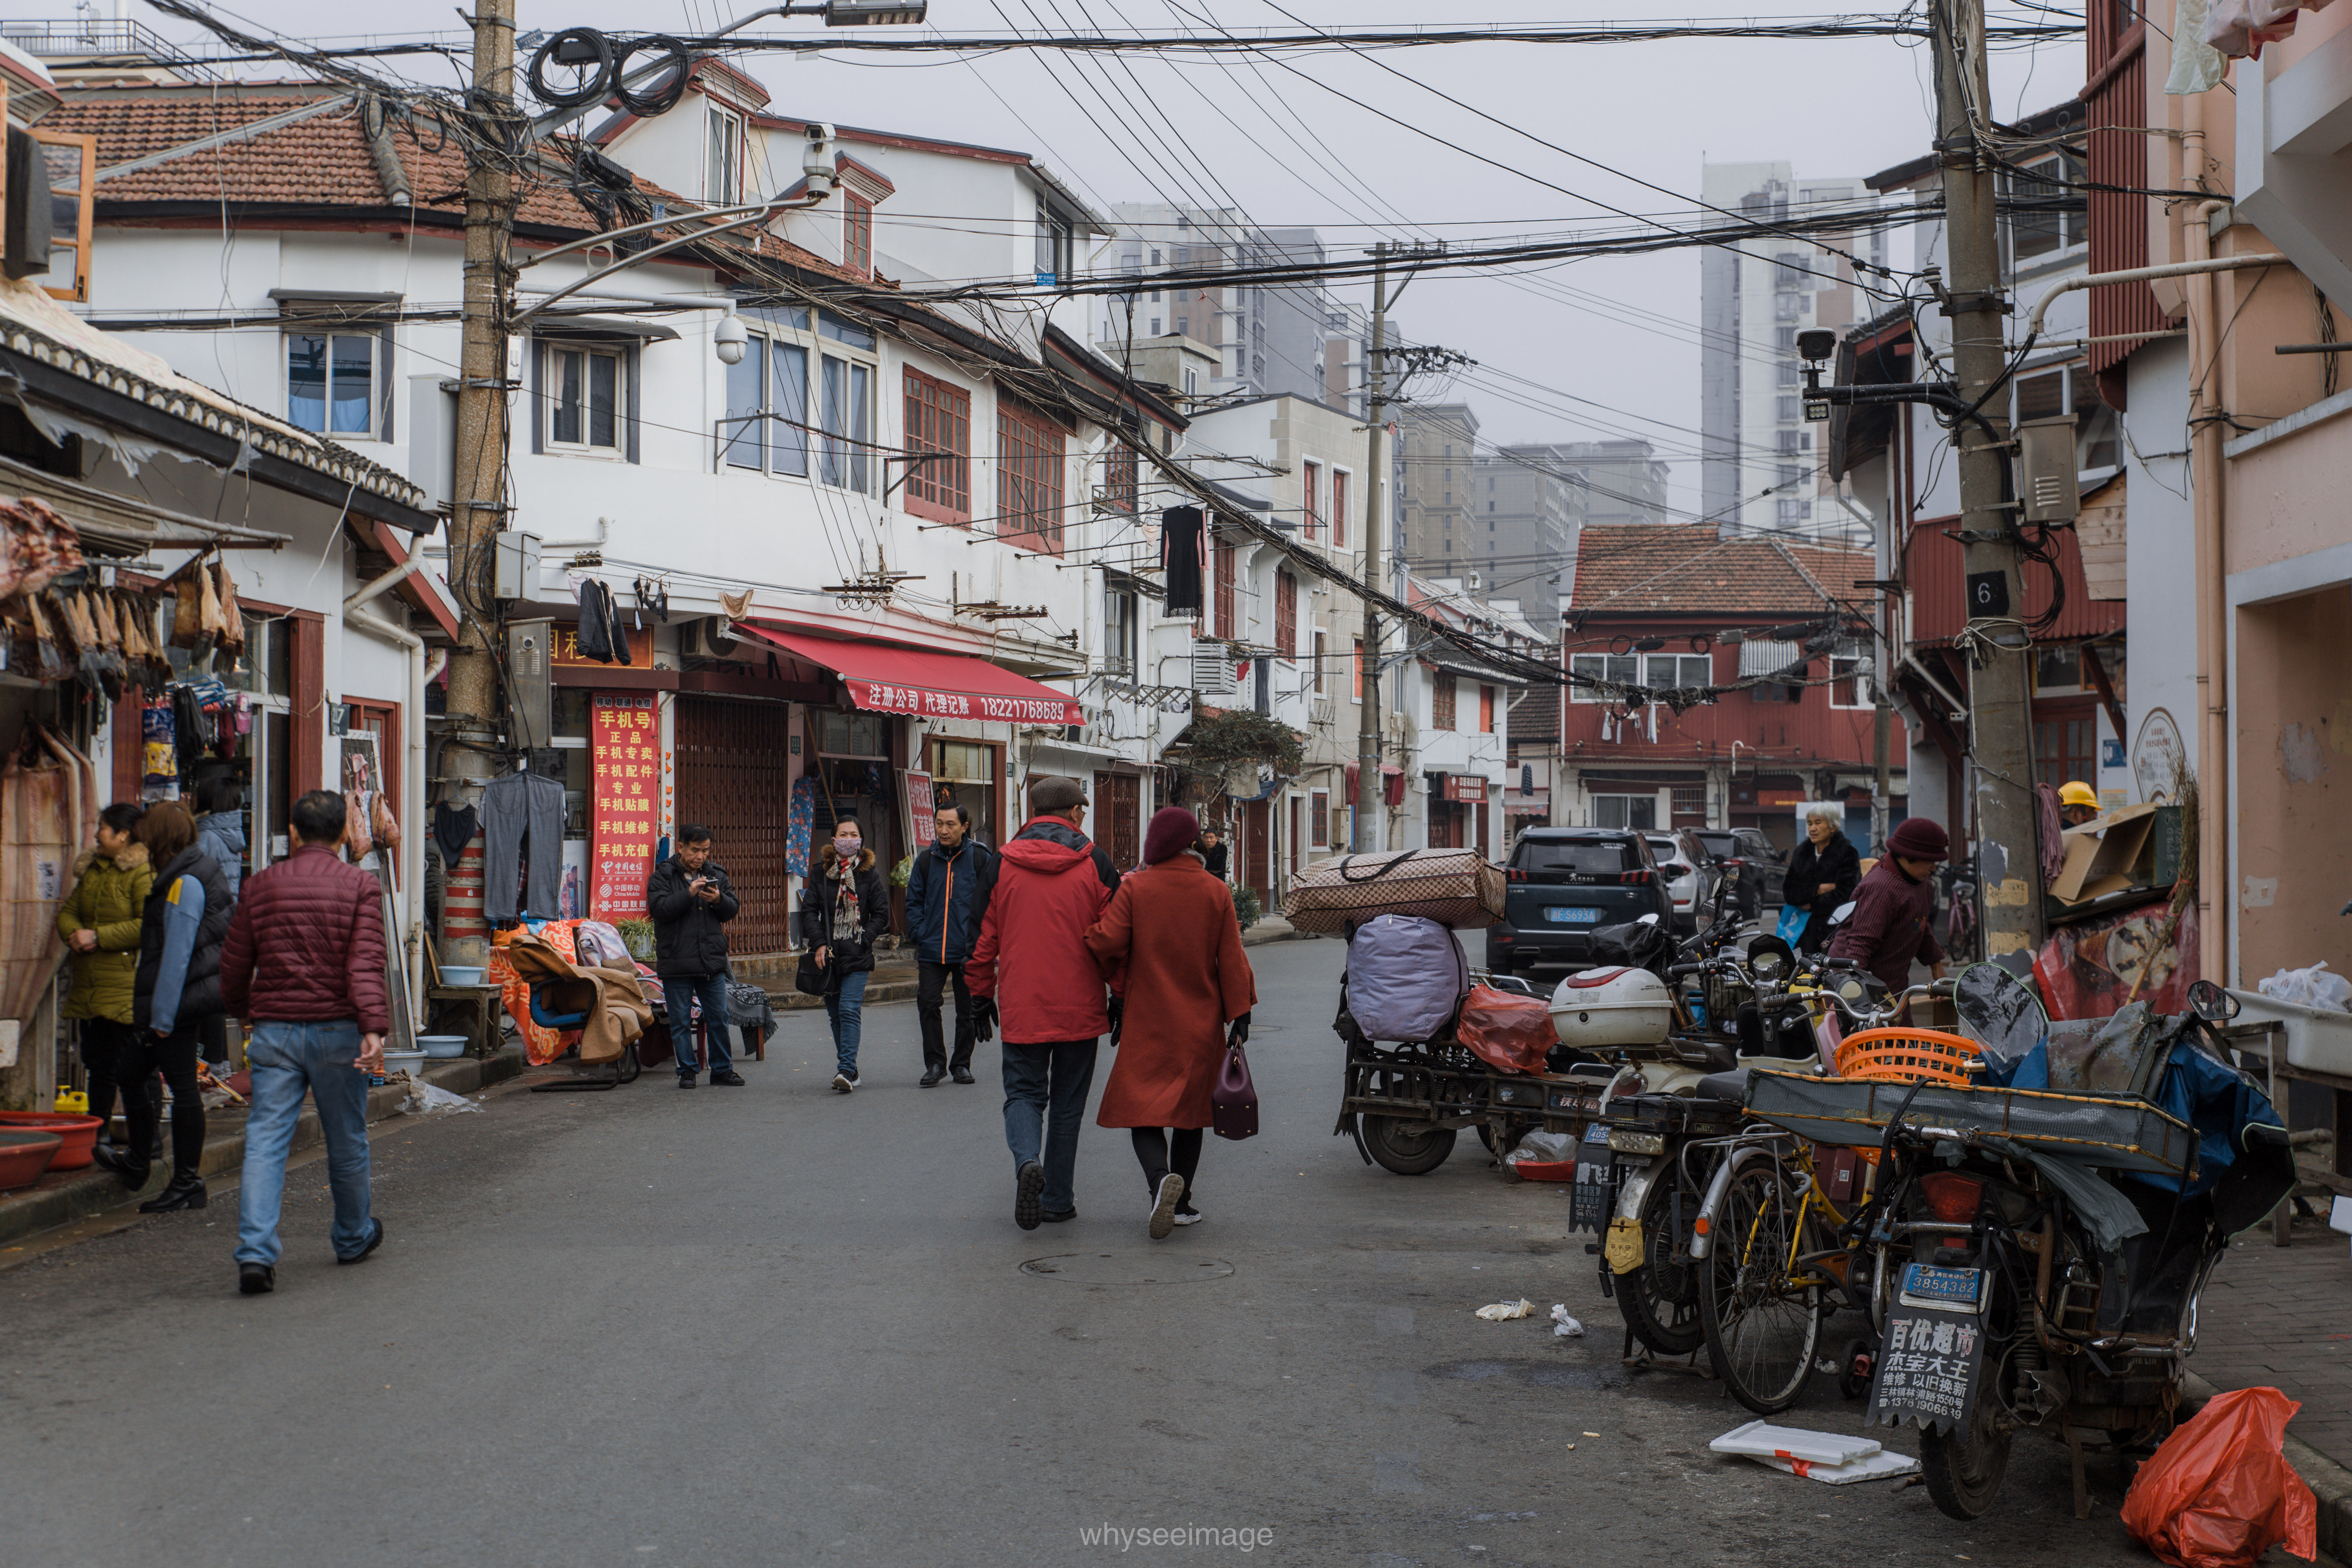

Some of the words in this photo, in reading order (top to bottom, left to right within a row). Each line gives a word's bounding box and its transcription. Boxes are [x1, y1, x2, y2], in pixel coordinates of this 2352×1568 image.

[1978, 582, 1990, 604] 6
[596, 697, 612, 707] 移动
[615, 698, 632, 708] 联通
[636, 698, 652, 708] 电信
[869, 684, 919, 711] 注册公司
[925, 692, 969, 715] 代理记账
[981, 698, 1064, 720] 18221768689
[599, 711, 651, 729] 手机号
[610, 732, 641, 744] 正品
[597, 746, 652, 760] 手机专卖
[597, 764, 653, 778] 手机配件
[612, 781, 642, 794] 专业
[909, 780, 932, 809] 冷饮批发
[599, 798, 649, 812] 手机贴膜
[599, 821, 649, 834] 手机维修
[913, 813, 936, 841] 厂家直销
[599, 843, 649, 857] 手机充值
[615, 862, 643, 871] 中国电信
[1913, 1277, 1975, 1293] 3854382
[1890, 1318, 1978, 1357] 百优超市
[1884, 1350, 1971, 1382] 杰宝大王
[1882, 1372, 1906, 1386] 维修
[1912, 1373, 1967, 1398] 以旧换新
